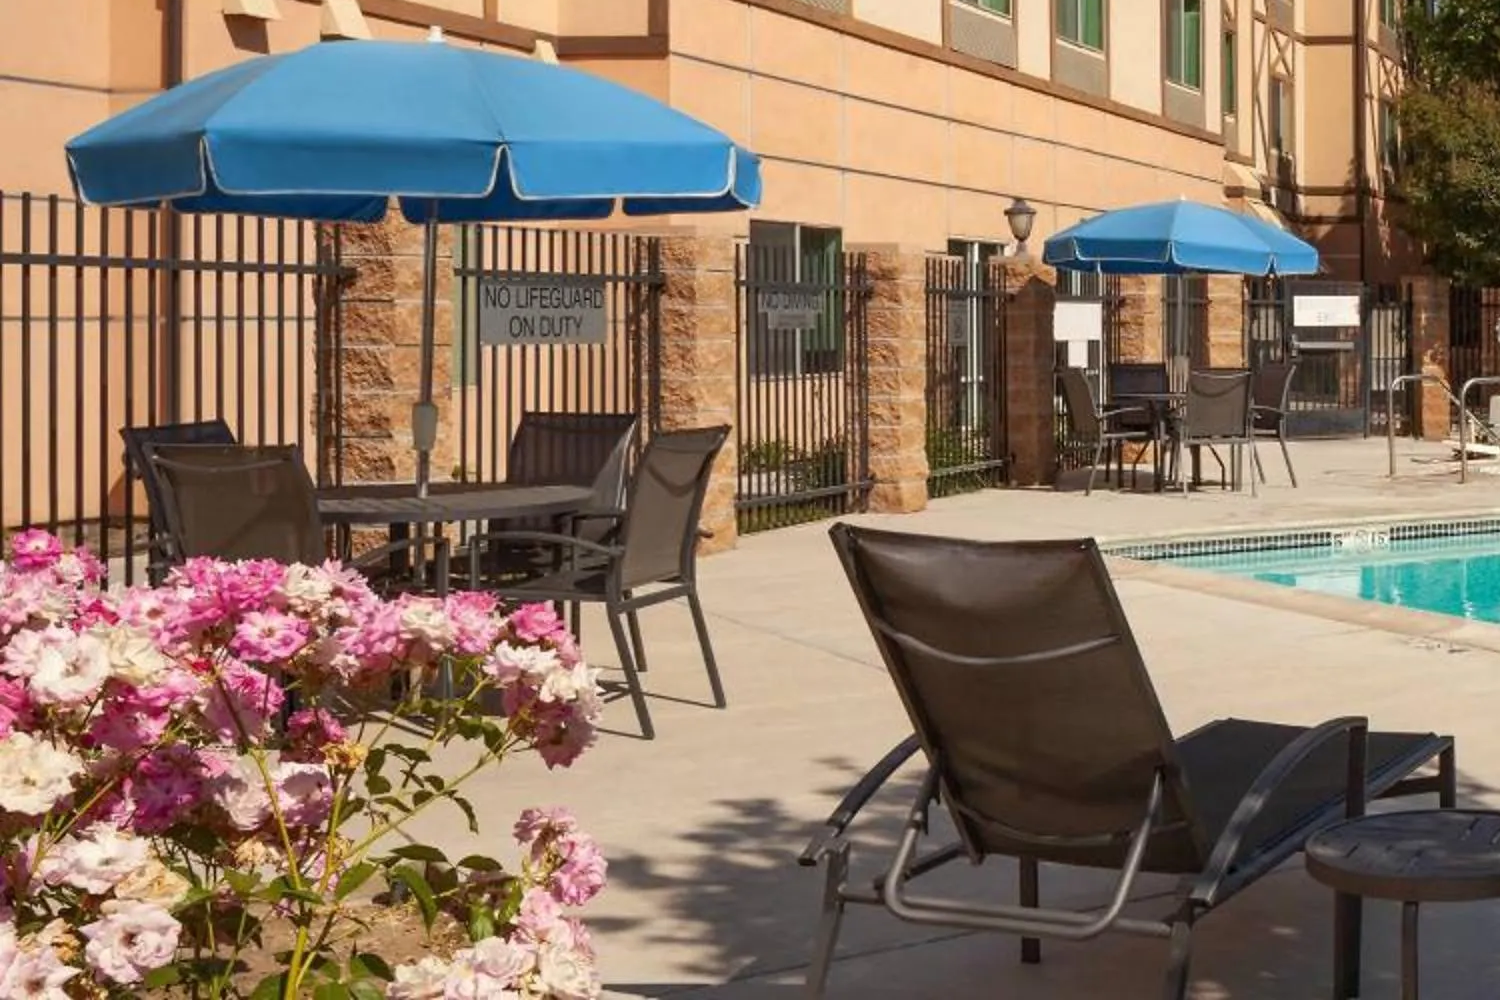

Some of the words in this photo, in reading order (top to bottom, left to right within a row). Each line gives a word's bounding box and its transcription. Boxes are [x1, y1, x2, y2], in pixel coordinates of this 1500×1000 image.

[485, 285, 511, 309] NO
[516, 286, 604, 309] LIFEGUARD
[509, 315, 535, 338] ON
[540, 315, 583, 338] DUTY
